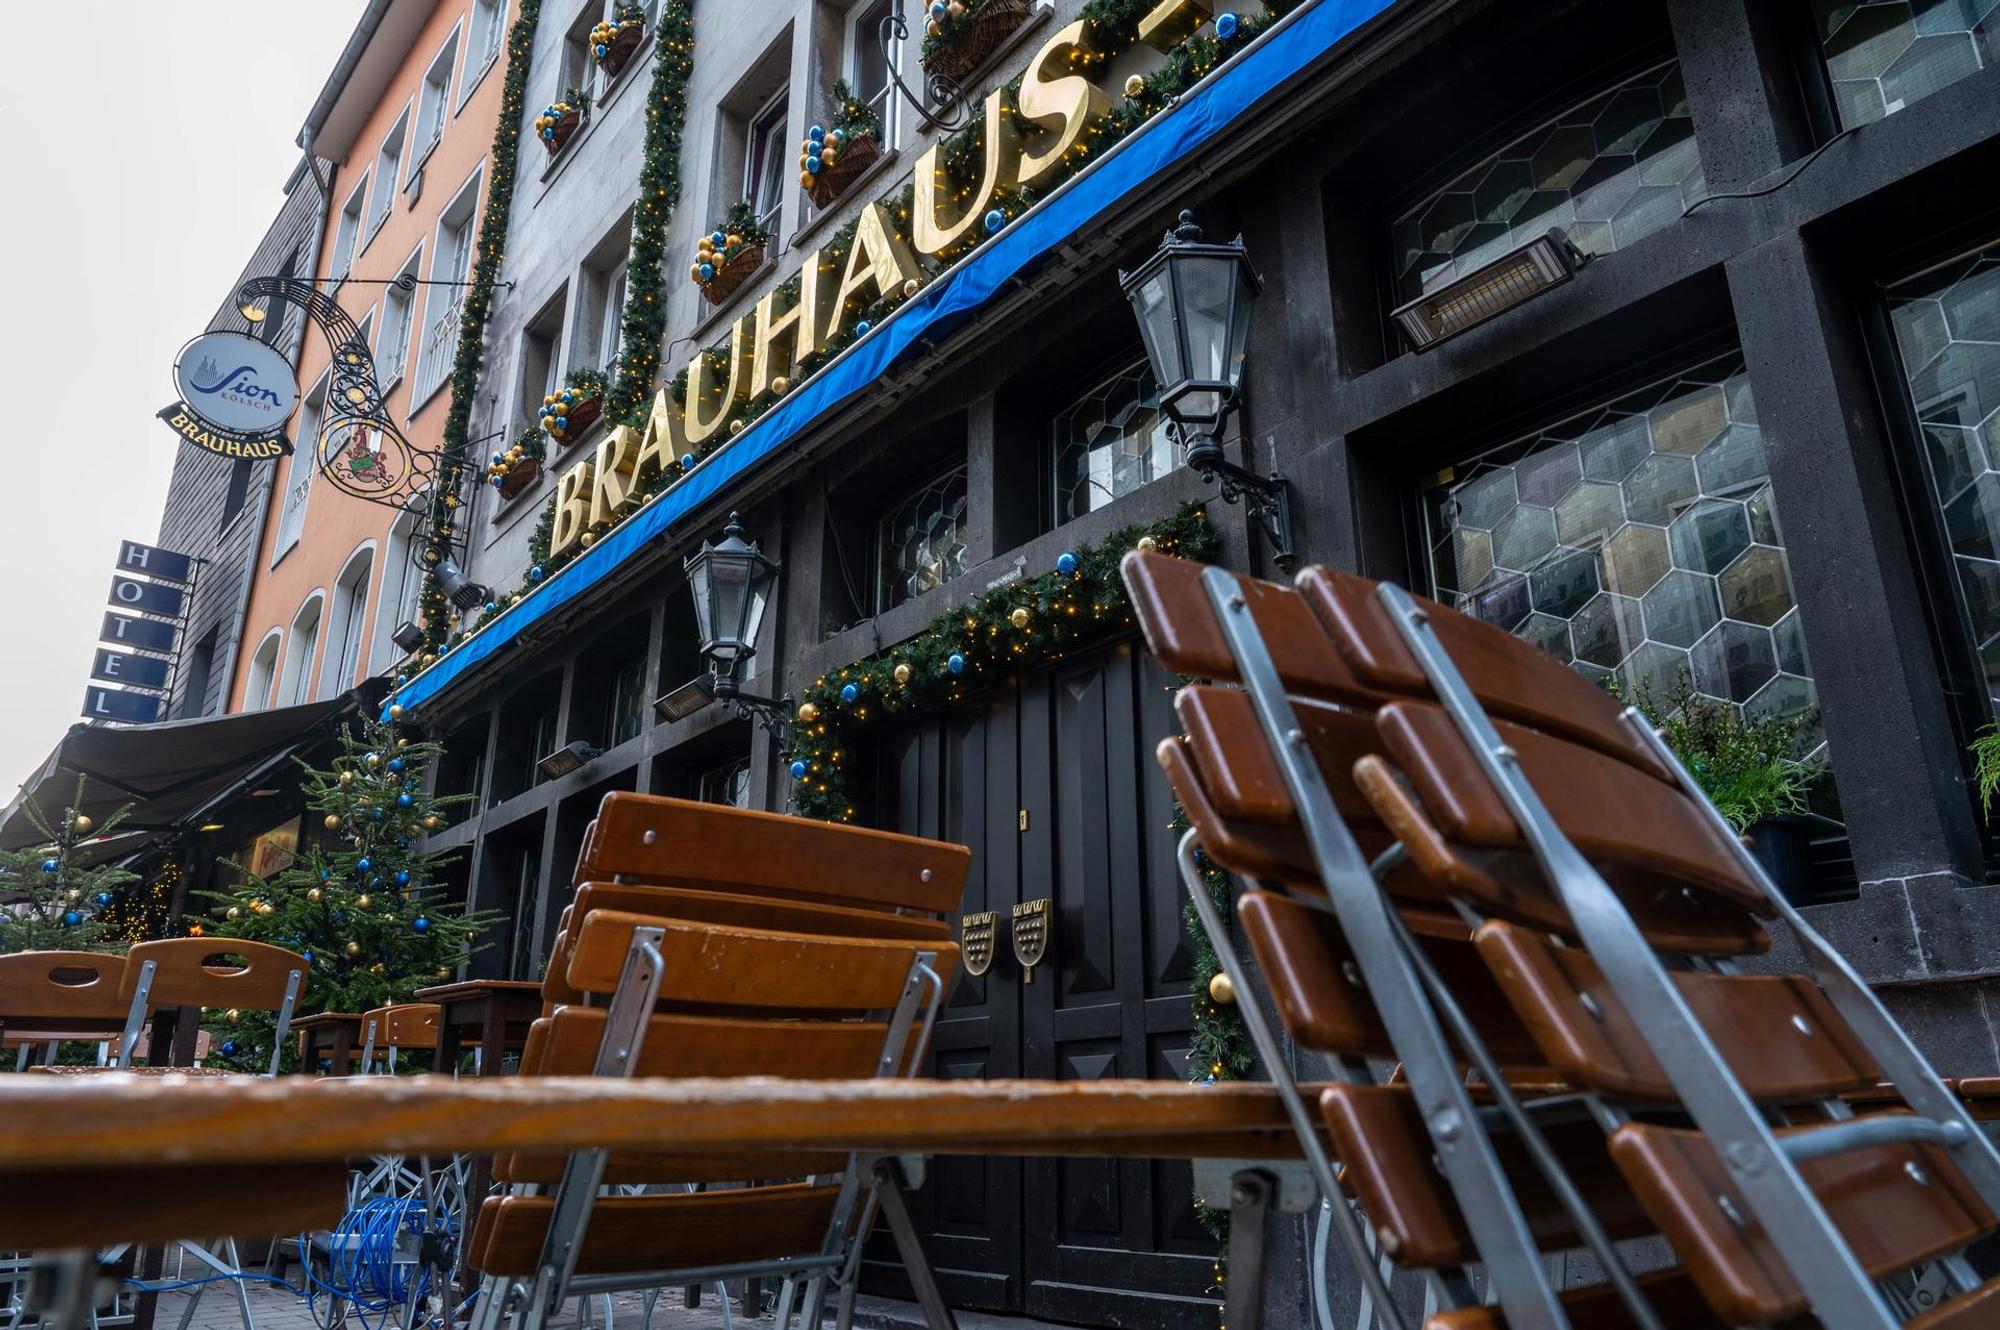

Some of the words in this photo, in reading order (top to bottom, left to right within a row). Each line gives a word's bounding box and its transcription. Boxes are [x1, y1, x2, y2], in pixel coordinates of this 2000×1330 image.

[549, 18, 1090, 559] BRAUHAUS
[170, 411, 283, 458] BRAUHAUS
[189, 365, 282, 406] Sion
[95, 546, 150, 713] HOTEL
